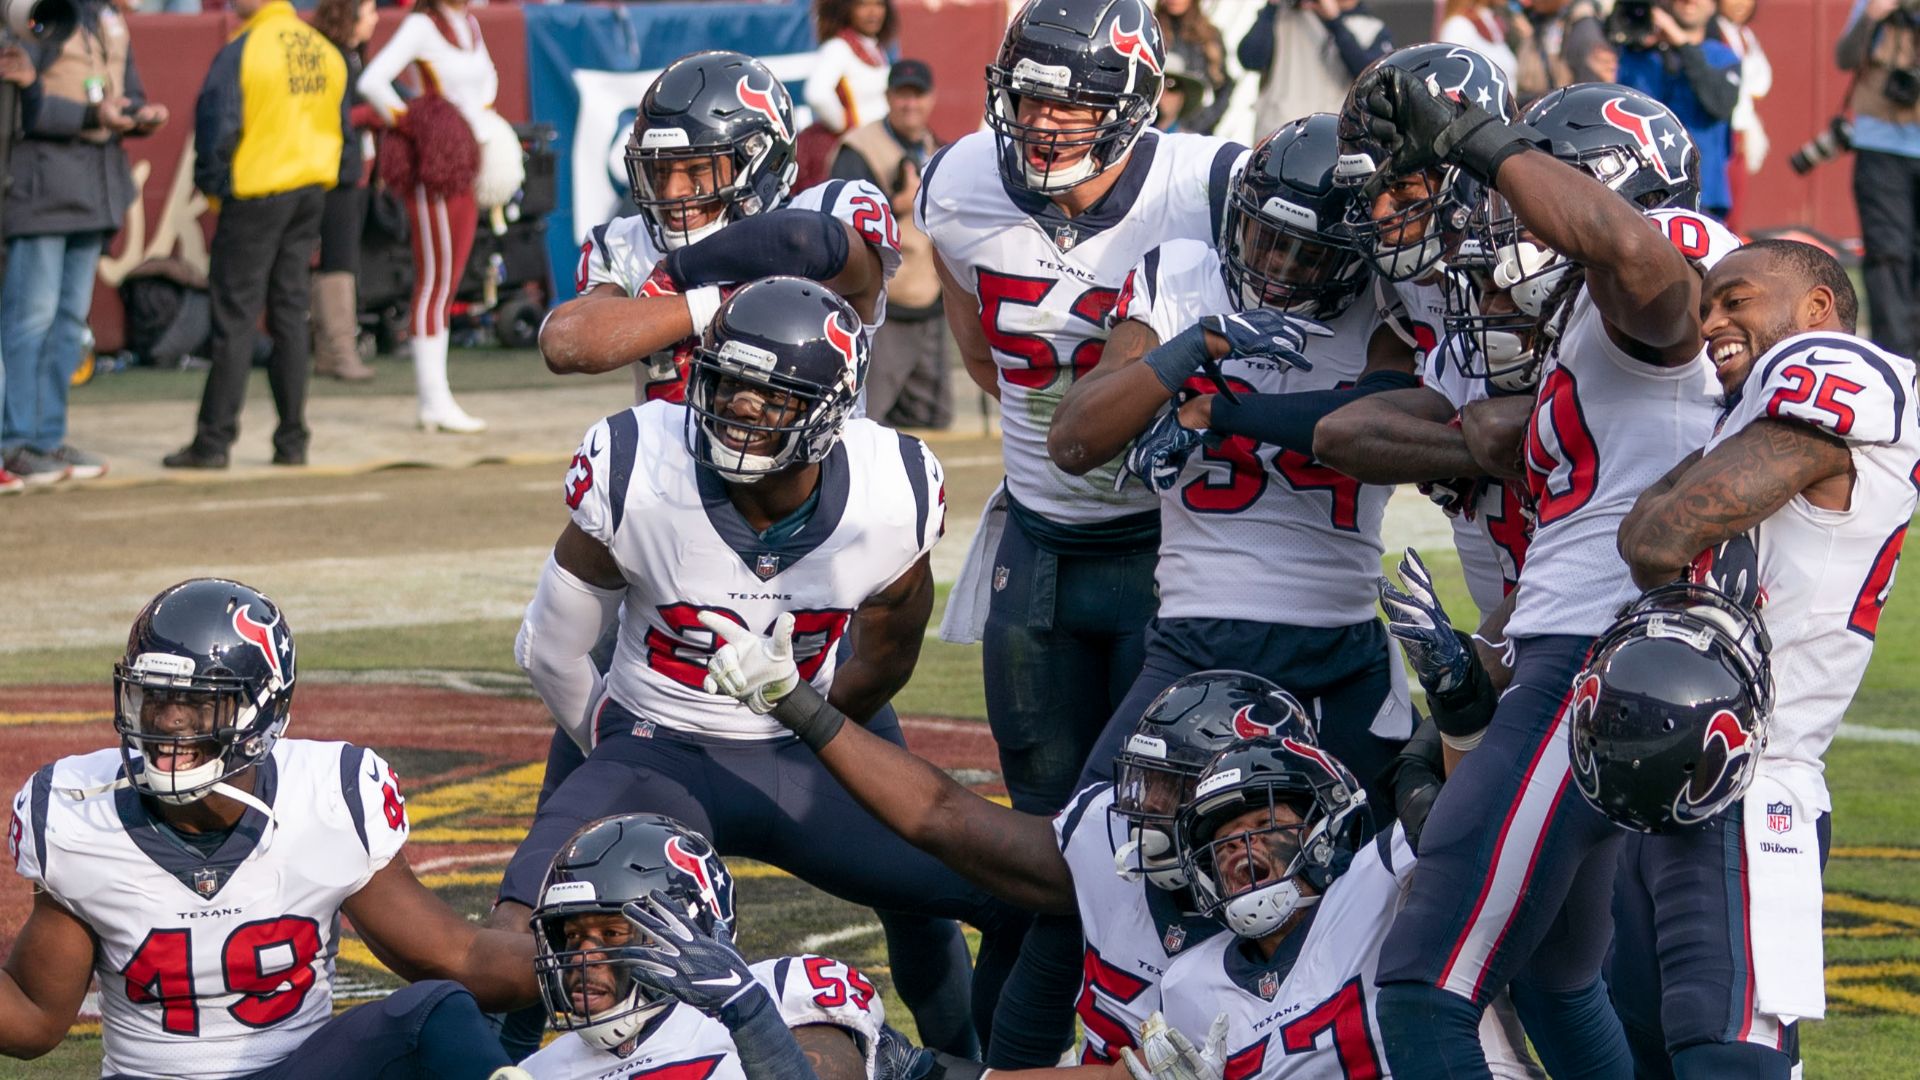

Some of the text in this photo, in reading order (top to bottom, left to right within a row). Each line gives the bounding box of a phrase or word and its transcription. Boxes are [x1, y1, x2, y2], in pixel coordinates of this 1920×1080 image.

[1274, 201, 1310, 218] TEXANS
[1036, 258, 1097, 280] TEXANS
[1244, 360, 1280, 371] TEX
[1766, 364, 1867, 436] 25
[727, 592, 793, 601] TEXANS
[1133, 737, 1158, 748] TEXANS
[1769, 815, 1790, 831] NFL
[1759, 841, 1799, 855] Wilson
[176, 907, 243, 920] TEXANS
[117, 914, 323, 1037] 49
[1137, 959, 1164, 977] TEX
[1252, 1002, 1301, 1033] TEXANS
[598, 1057, 653, 1080] TEXANS
